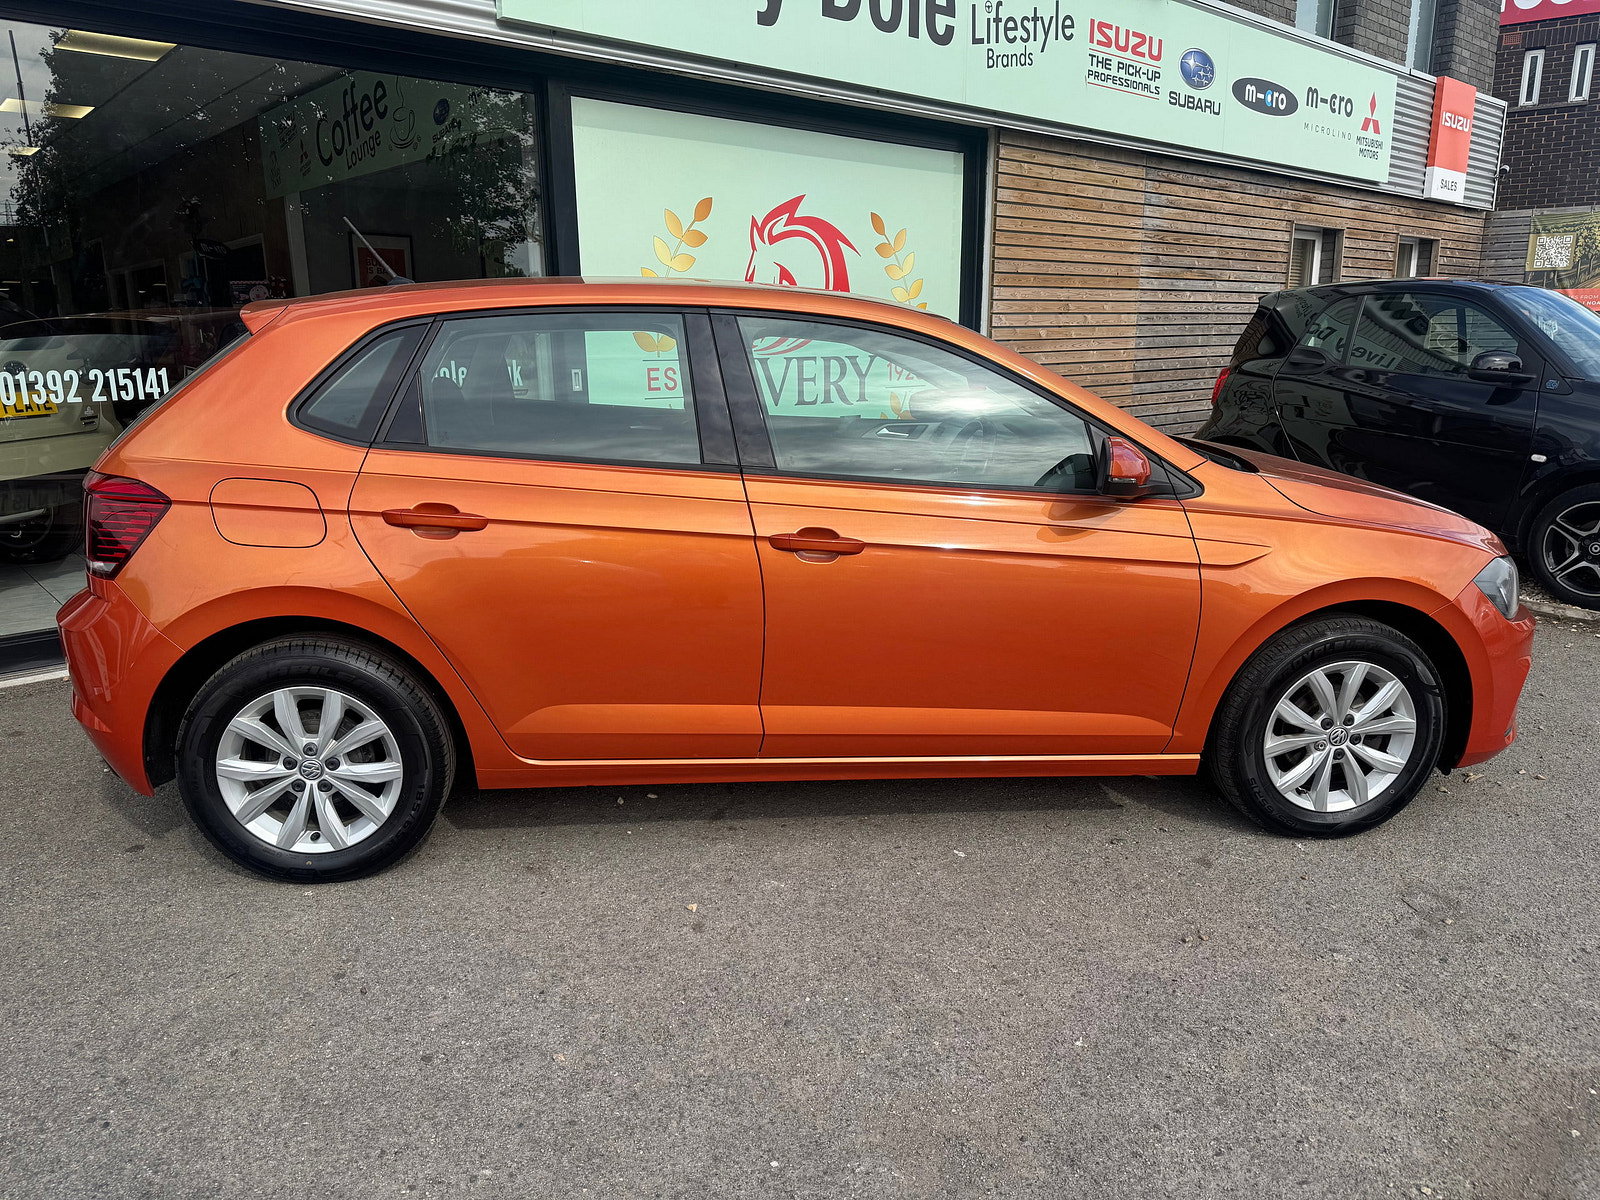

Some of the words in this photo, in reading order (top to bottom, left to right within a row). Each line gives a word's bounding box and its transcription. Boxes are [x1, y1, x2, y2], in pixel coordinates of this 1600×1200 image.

[970, 0, 1075, 53] Lifestyle
[1088, 18, 1163, 62] ISUZU
[986, 45, 1034, 69] Brands
[1088, 53, 1113, 71] THE
[1117, 60, 1161, 83] PICK-UP
[1087, 69, 1161, 96] PROFESSIONALS
[1168, 90, 1221, 116] SUBARU
[316, 79, 389, 168] Coffee
[1303, 122, 1352, 141] MICROLINO
[1441, 111, 1471, 132] ISUZU
[345, 129, 382, 171] Lounge
[1355, 135, 1384, 150] MITSUBISHI
[1358, 149, 1379, 161] MOTORS
[1440, 178, 1458, 192] SALES
[886, 361, 924, 382] 192
[0, 369, 83, 406] 01392
[88, 367, 170, 402] 215141
